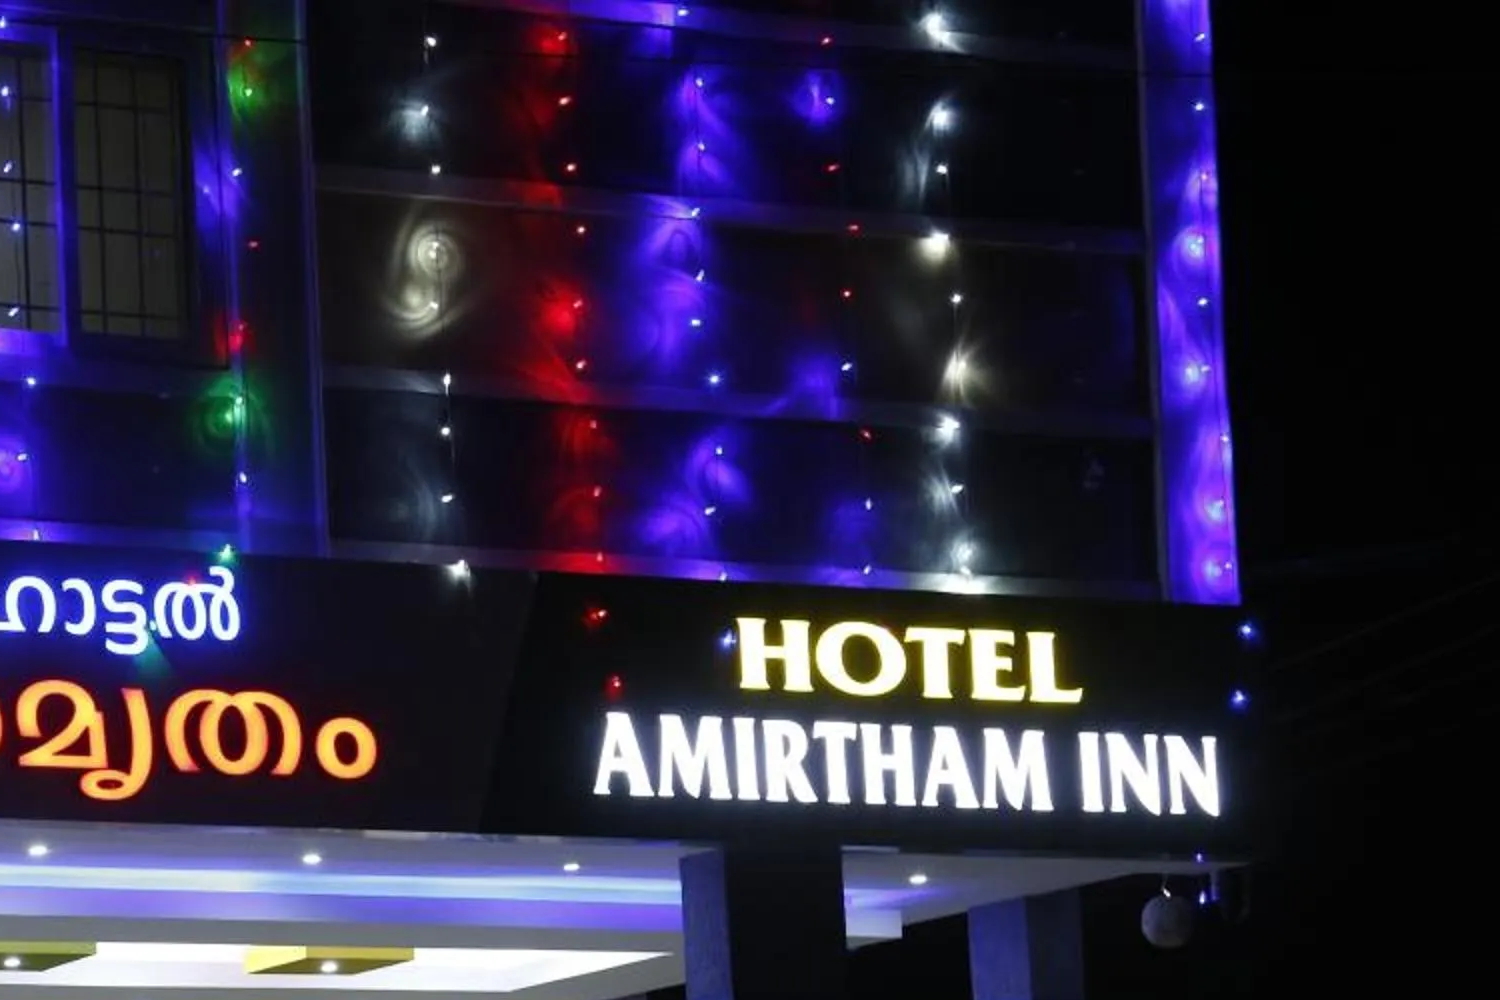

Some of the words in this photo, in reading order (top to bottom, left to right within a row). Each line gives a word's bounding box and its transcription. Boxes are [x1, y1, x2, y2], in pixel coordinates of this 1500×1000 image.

[735, 616, 1084, 704] HOTEL
[592, 710, 1055, 813] AMIRTHAM
[1077, 730, 1222, 818] INN
